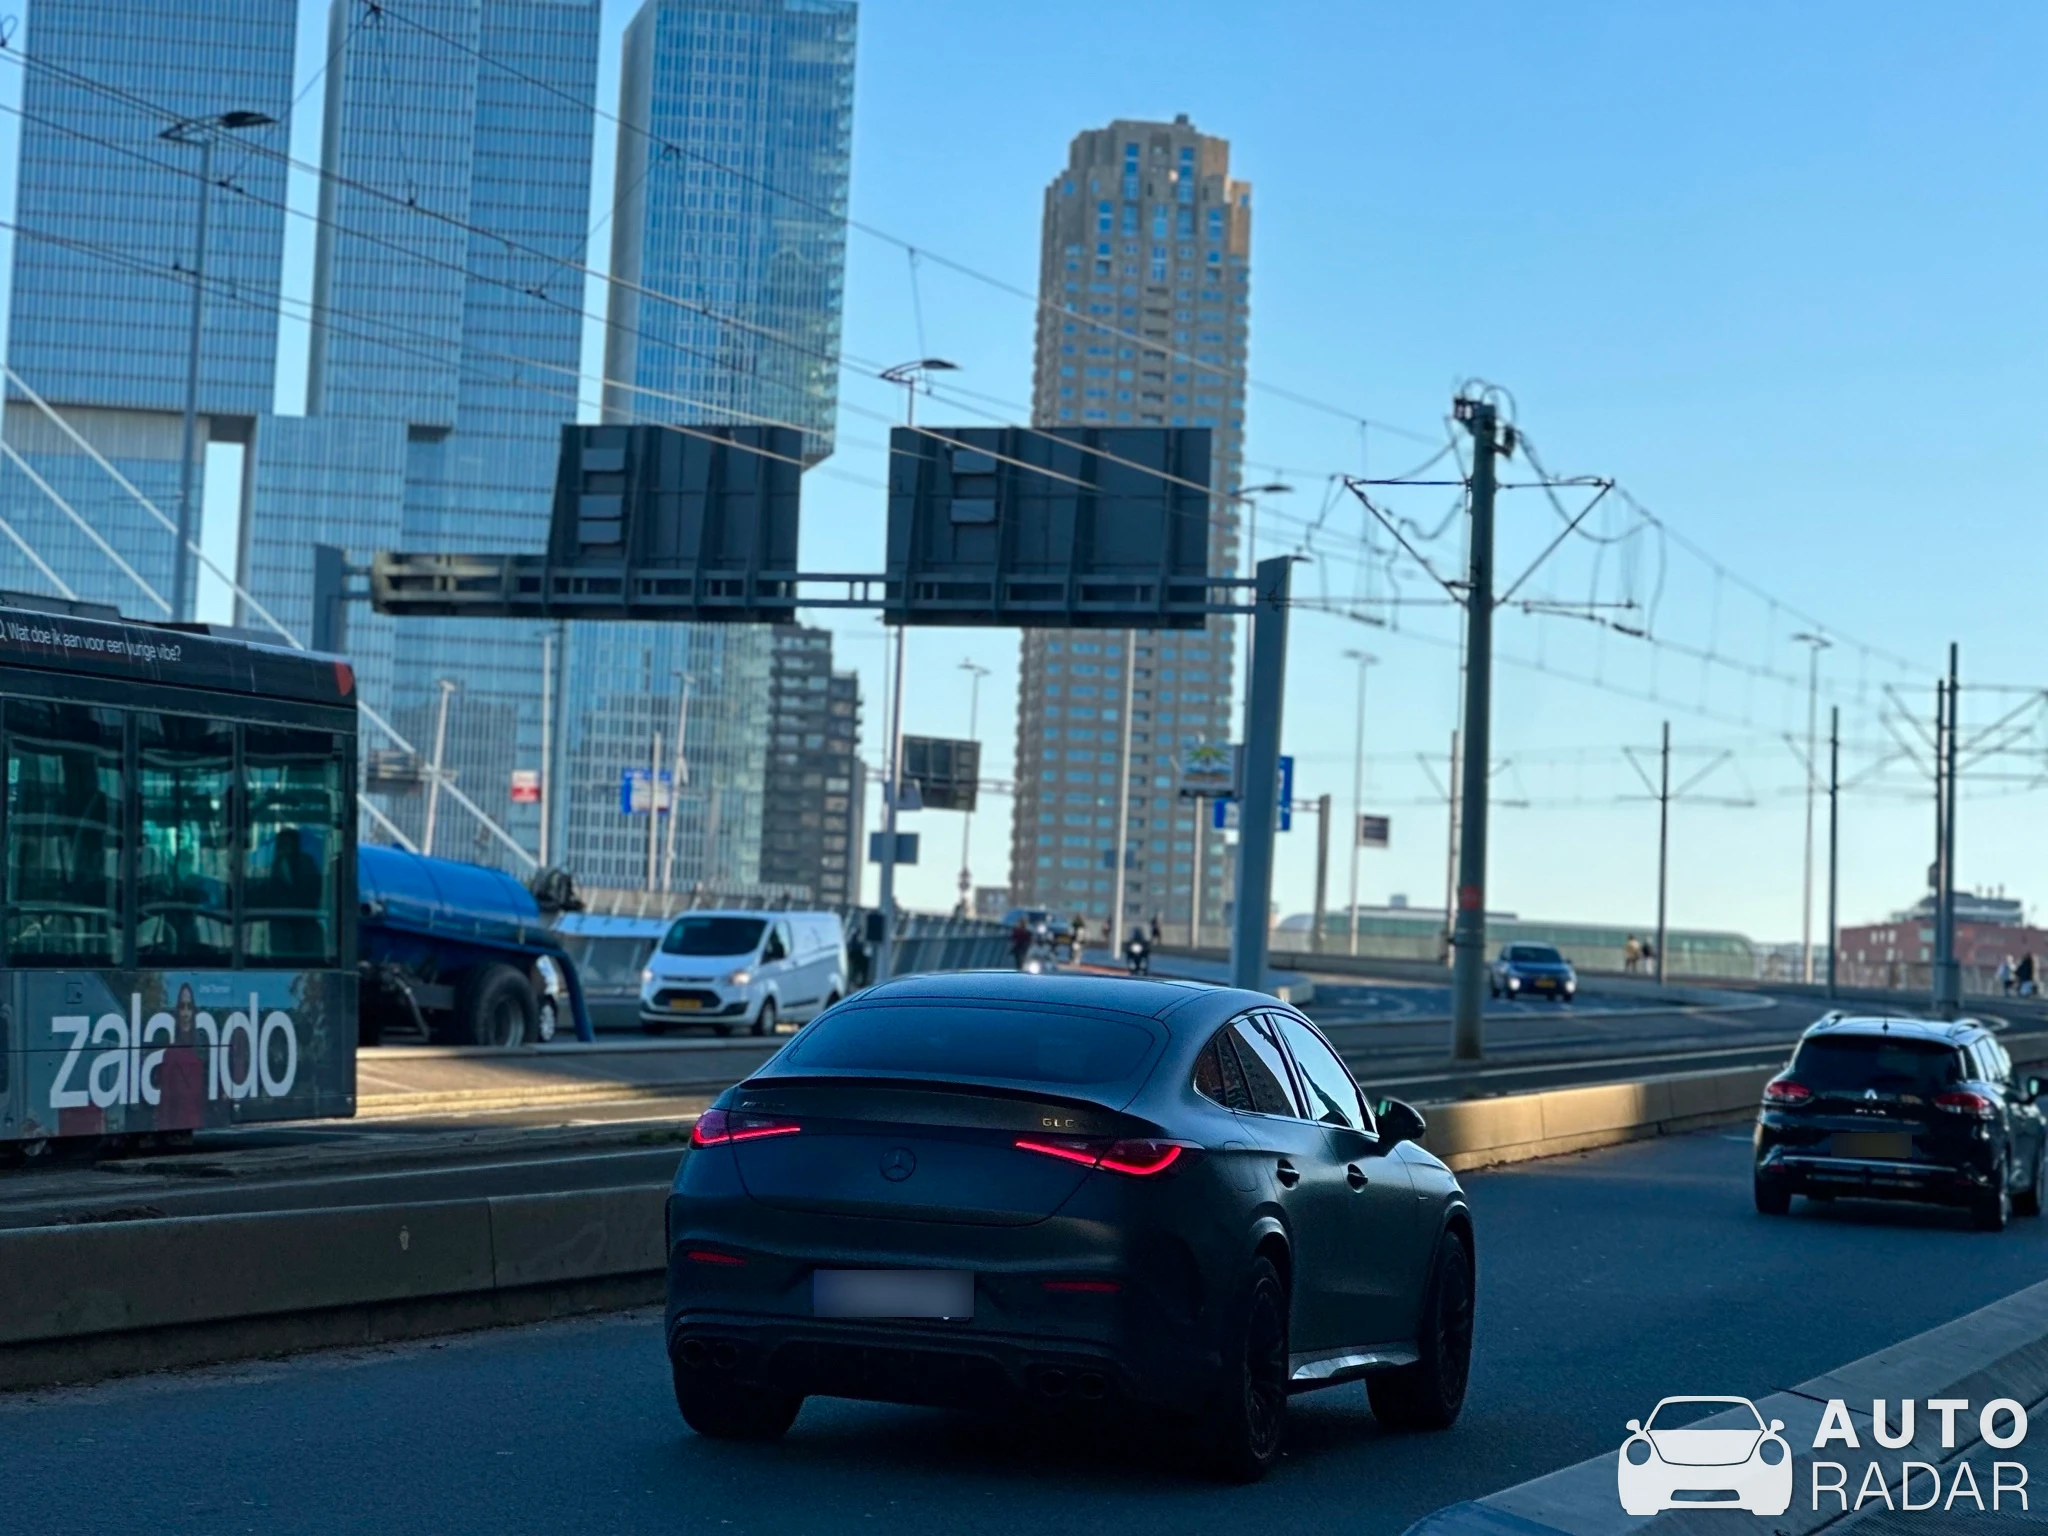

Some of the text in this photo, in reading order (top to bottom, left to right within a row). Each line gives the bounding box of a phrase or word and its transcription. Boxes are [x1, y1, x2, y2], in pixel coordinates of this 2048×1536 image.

[6, 622, 30, 641] Wat
[31, 625, 52, 644] doe
[52, 628, 63, 646] ik
[63, 633, 83, 648] aan
[83, 636, 105, 652] voor
[106, 640, 126, 654] een
[157, 643, 181, 661] vibe?
[50, 992, 298, 1108] zalando
[1042, 1118, 1075, 1127] GLC
